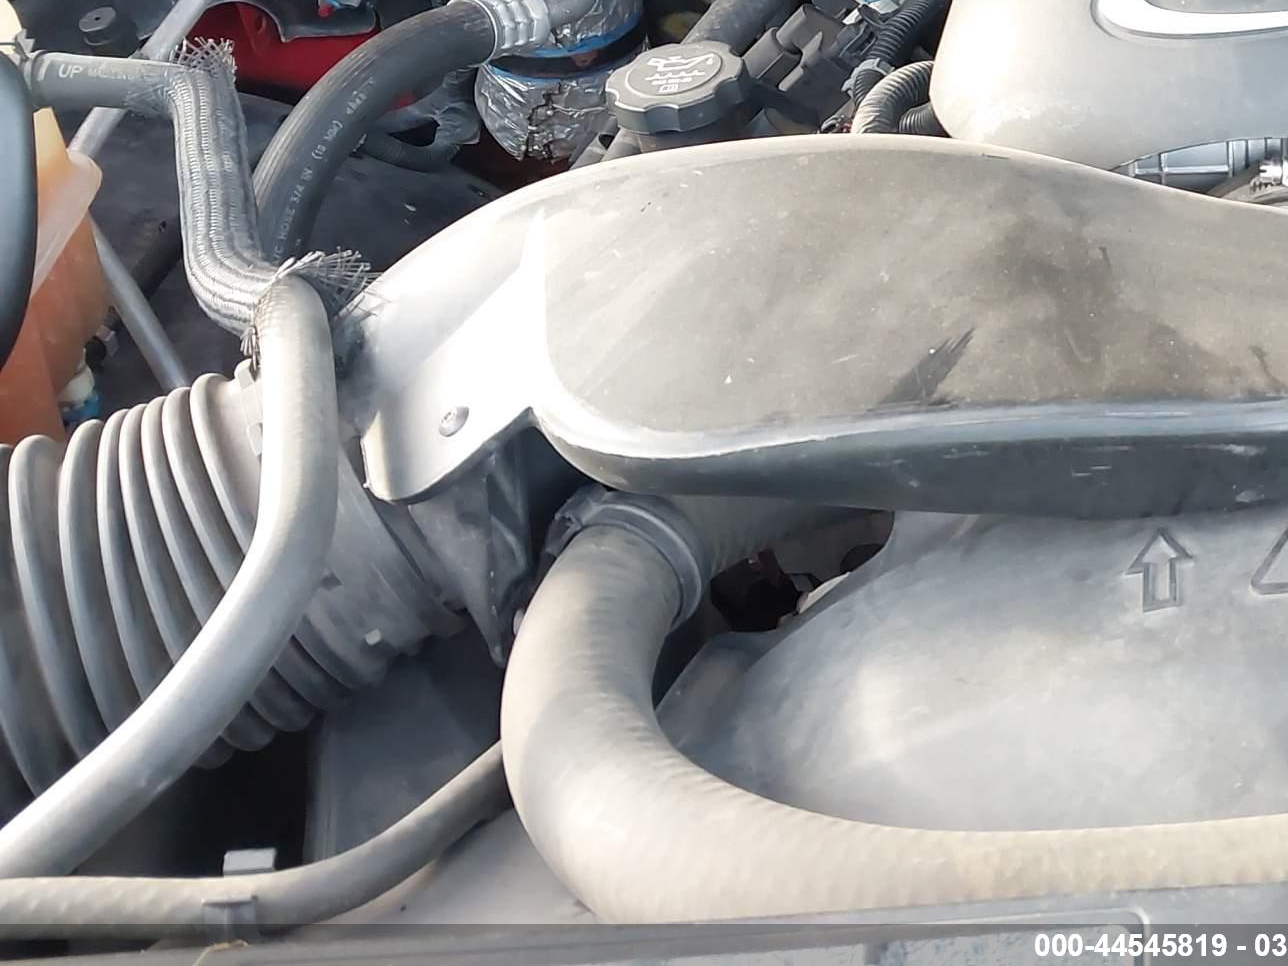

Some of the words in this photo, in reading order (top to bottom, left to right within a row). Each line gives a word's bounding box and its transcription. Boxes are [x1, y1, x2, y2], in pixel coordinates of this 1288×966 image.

[58, 63, 83, 79] UP
[279, 207, 296, 238] HOSE
[290, 184, 306, 203] 3/4
